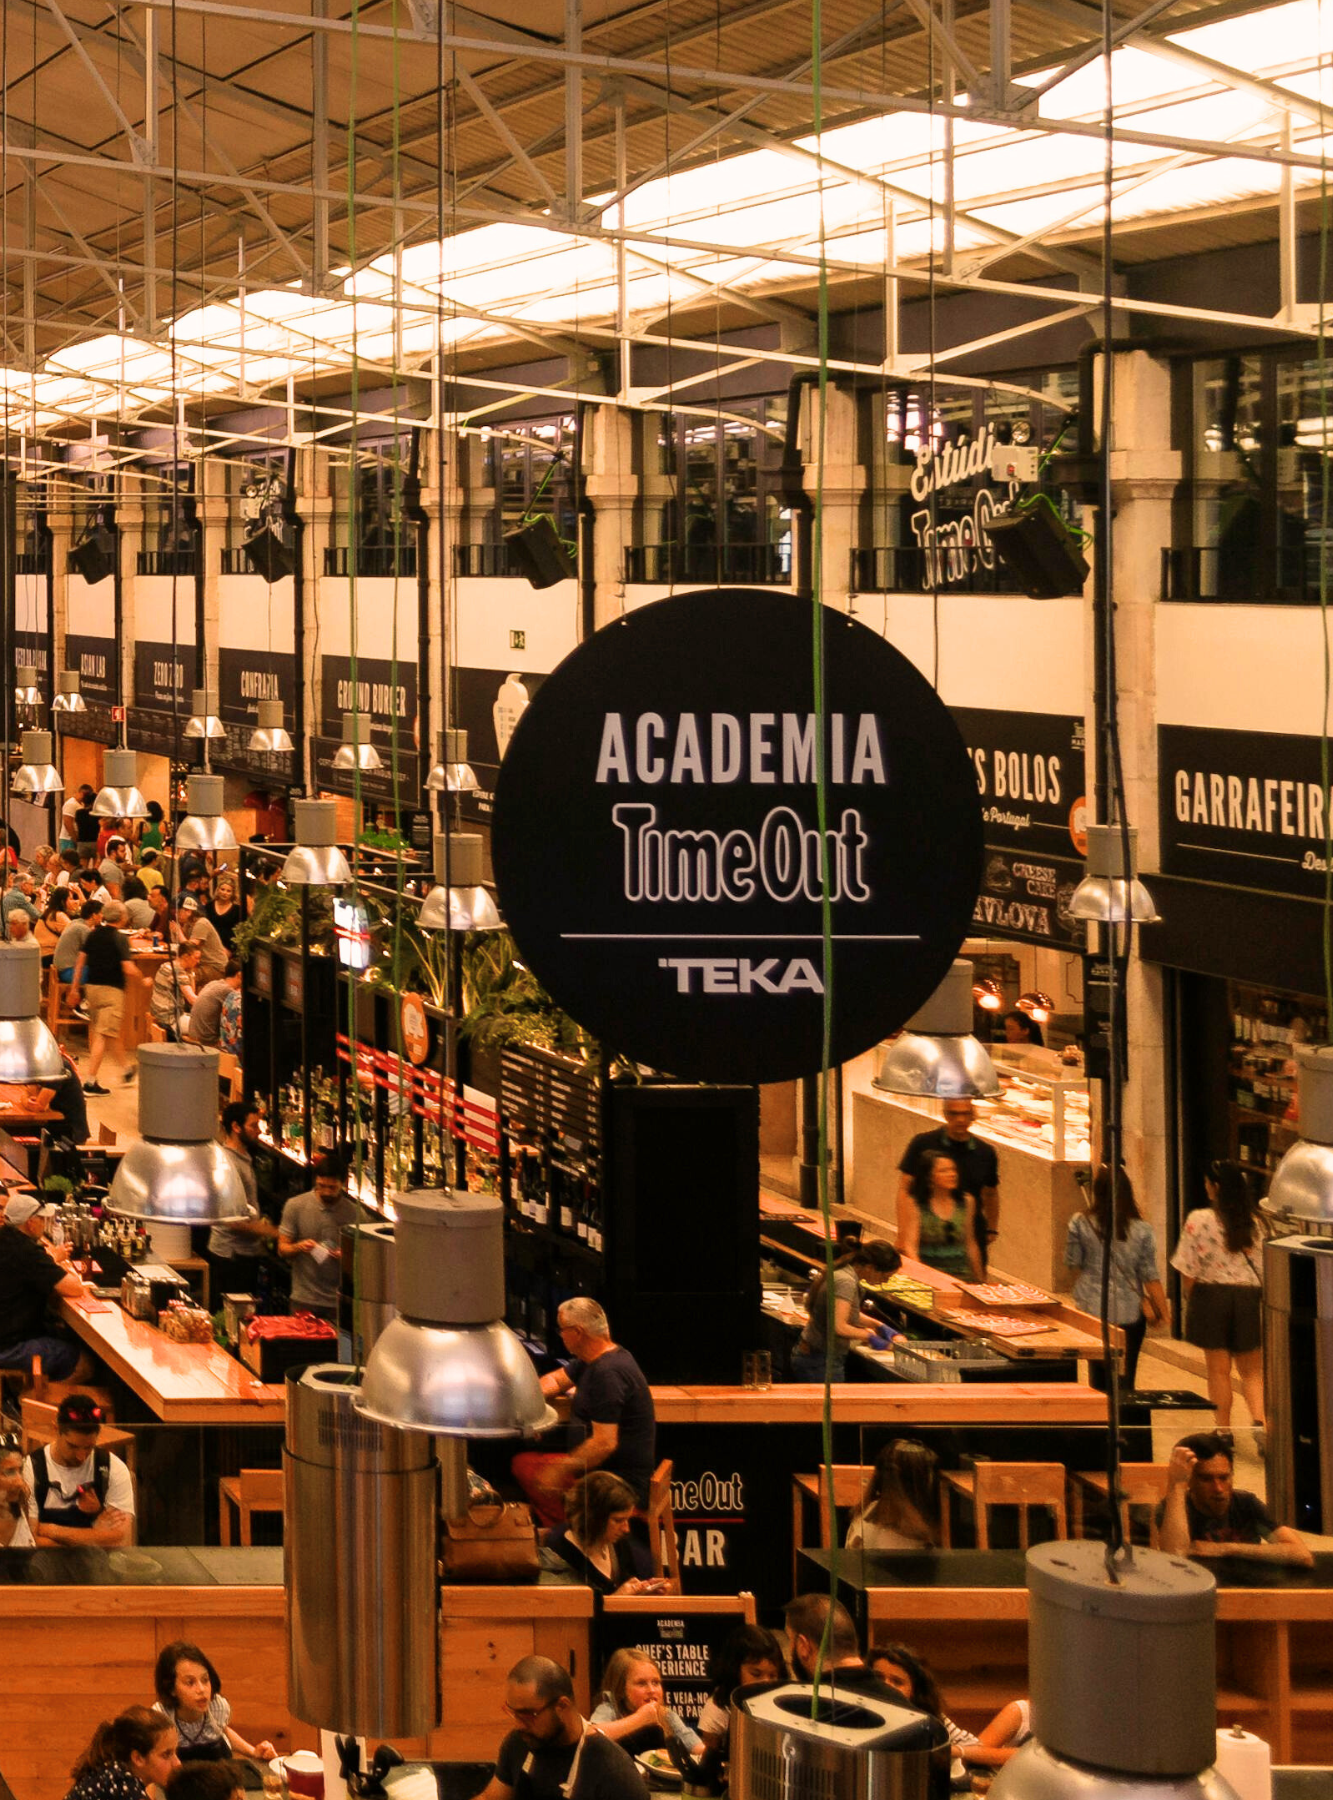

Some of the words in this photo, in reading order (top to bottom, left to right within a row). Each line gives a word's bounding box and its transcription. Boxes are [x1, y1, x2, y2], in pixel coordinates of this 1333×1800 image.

[911, 421, 997, 502] Estúdi
[169, 663, 184, 689] ZRO
[595, 711, 886, 784] ACADEMIA
[967, 747, 987, 795] S
[994, 750, 1060, 804] BOLOS
[990, 806, 1031, 831] Portugal
[1175, 769, 1333, 840] GARRAFEIR
[611, 802, 757, 902] Time
[759, 805, 870, 902] Out
[1301, 851, 1333, 872] Des
[1026, 878, 1057, 899] CAKE
[659, 958, 824, 993] TEKA
[699, 1471, 744, 1511] Out
[675, 1644, 710, 1661] TABLE
